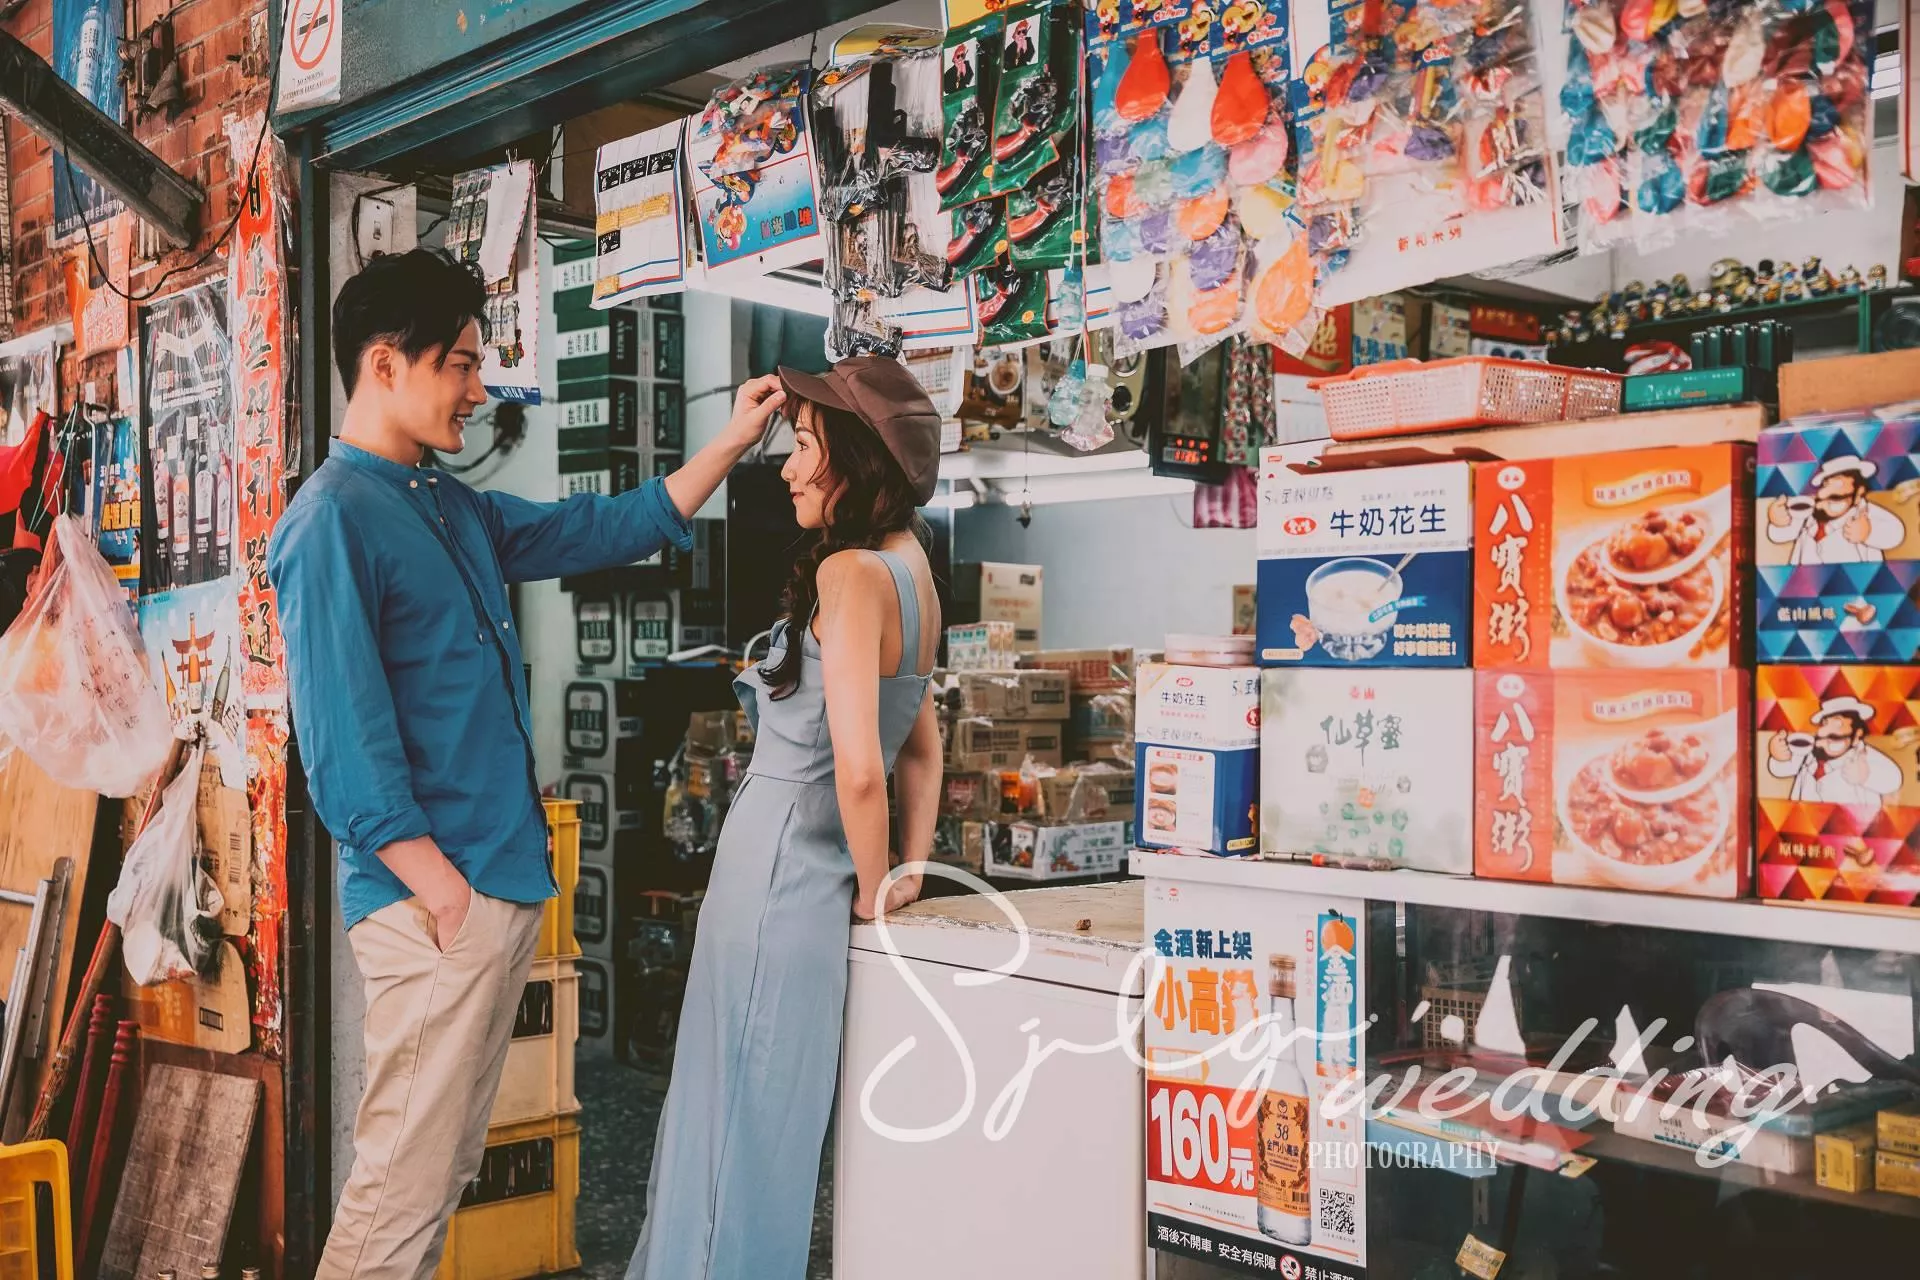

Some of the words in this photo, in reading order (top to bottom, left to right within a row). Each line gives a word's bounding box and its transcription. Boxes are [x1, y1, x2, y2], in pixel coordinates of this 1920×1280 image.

[1329, 503, 1447, 538] 牛奶花生
[1488, 493, 1534, 662] 八寶粥
[1161, 691, 1206, 706] 牛奶花生
[1319, 708, 1403, 768] 仙草蜜
[1490, 702, 1535, 873] 八寶粥
[1153, 928, 1253, 960] 金酒新上架
[1150, 1088, 1256, 1192] 160元
[1275, 1122, 1290, 1142] 38
[1157, 1224, 1213, 1253] 酒後不開車
[1217, 1242, 1277, 1272] 安全有保障
